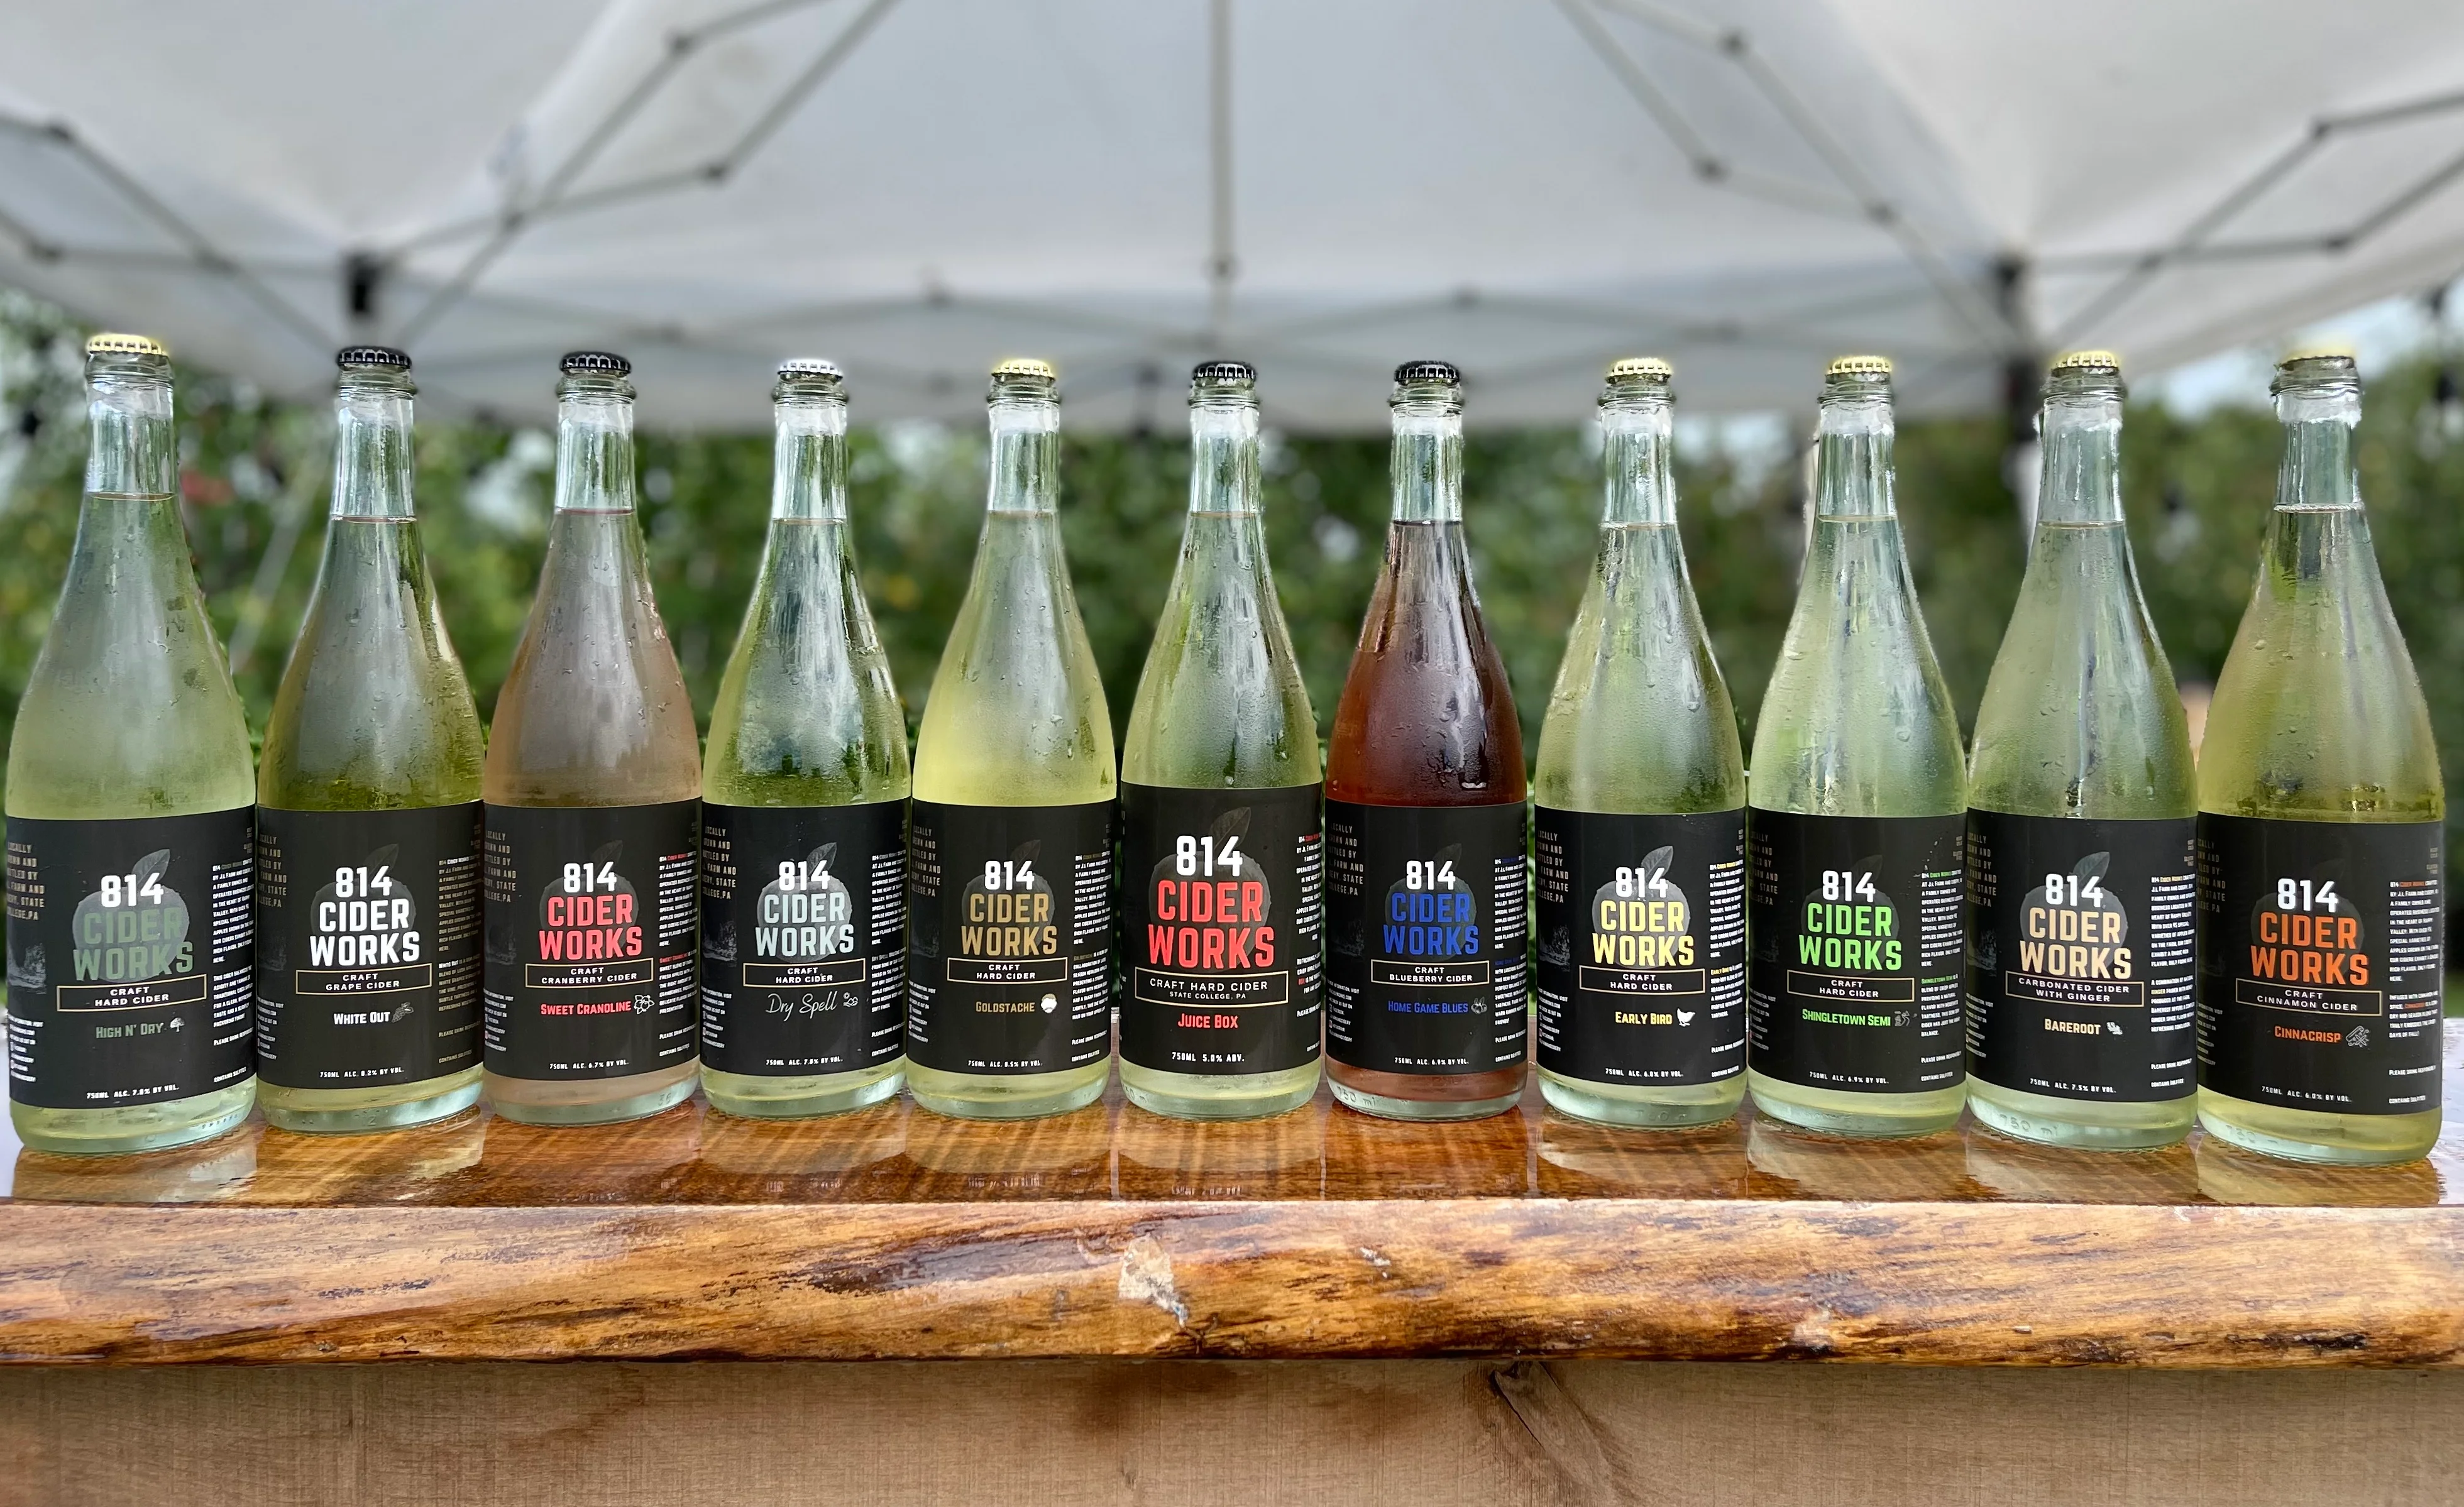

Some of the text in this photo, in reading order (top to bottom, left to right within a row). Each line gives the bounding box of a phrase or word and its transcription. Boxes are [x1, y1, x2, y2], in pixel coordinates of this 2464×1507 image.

[1177, 836, 1242, 876] 814
[1348, 850, 1356, 859] BY
[1350, 863, 1363, 872] AND
[102, 873, 163, 907] 814
[336, 866, 392, 897] 814
[564, 862, 617, 892] 814
[779, 860, 830, 890] 814
[985, 861, 1034, 890] 814
[1343, 874, 1363, 885] STATE
[1407, 861, 1455, 889] 814
[1616, 867, 1668, 897] 814
[1823, 871, 1875, 902] 814
[1157, 880, 1263, 923] CIDER
[2046, 874, 2103, 907] 814
[2279, 879, 2338, 912] 814
[319, 898, 409, 932] CIDER
[547, 893, 632, 926] CIDER
[764, 892, 845, 924] CIDER
[969, 893, 1049, 923] CIDER
[1392, 893, 1470, 923] CIDER
[1601, 900, 1683, 933] CIDER
[1807, 902, 1892, 937] CIDER
[84, 907, 185, 945] CIDER
[755, 924, 854, 957] WORKS
[961, 925, 1057, 956] WORKS
[1383, 924, 1479, 955] WORKS
[2029, 907, 2121, 944] CIDER
[2260, 912, 2358, 950] CIDER
[310, 931, 420, 967] WORKS
[539, 926, 642, 960] WORKS
[1148, 924, 1275, 969] WORKS
[1592, 933, 1695, 967] WORKS
[1799, 935, 1903, 971] WORKS
[73, 941, 194, 980] WORKS
[2020, 941, 2132, 979] WORKS
[2251, 945, 2369, 985] WORKS
[110, 987, 149, 995] CRAFT
[607, 973, 637, 982] CIDER
[805, 973, 832, 982] CIDER
[1150, 978, 1267, 991] CRAFT HARD CIDER
[1390, 974, 1443, 982] BLUEBERRY
[1820, 987, 1845, 995] HARD
[2018, 977, 2094, 992] CARBONATED
[133, 994, 168, 1004] CIDER
[541, 1004, 574, 1014] SWEET
[766, 990, 838, 1022] Dry Spell
[976, 1002, 1035, 1012] GOLDSTACHE
[1389, 1001, 1468, 1013] HOME GAME BLUES
[2036, 990, 2109, 1002] WITH GINGER
[2257, 995, 2317, 1009] CINNAMON
[2285, 990, 2323, 999] CRAFT
[95, 1025, 123, 1039] HIGH
[140, 1022, 163, 1036] DRY
[334, 1012, 390, 1024] WHITE OUT
[1178, 1014, 1238, 1028] JUICE BOX
[1615, 1012, 1672, 1024] EARLY BIRD
[1803, 1009, 1890, 1026] SHINGLETOWN SEMI
[2045, 1019, 2101, 1034] BAREROOT
[2275, 1026, 2341, 1043] CINNACRISP
[1172, 1052, 1196, 1061] 750ML
[1202, 1054, 1222, 1062] 5.0%
[1810, 1071, 1828, 1080] 750ML
[2030, 1078, 2050, 1087] 750ML
[2262, 1086, 2282, 1095] 750ML
